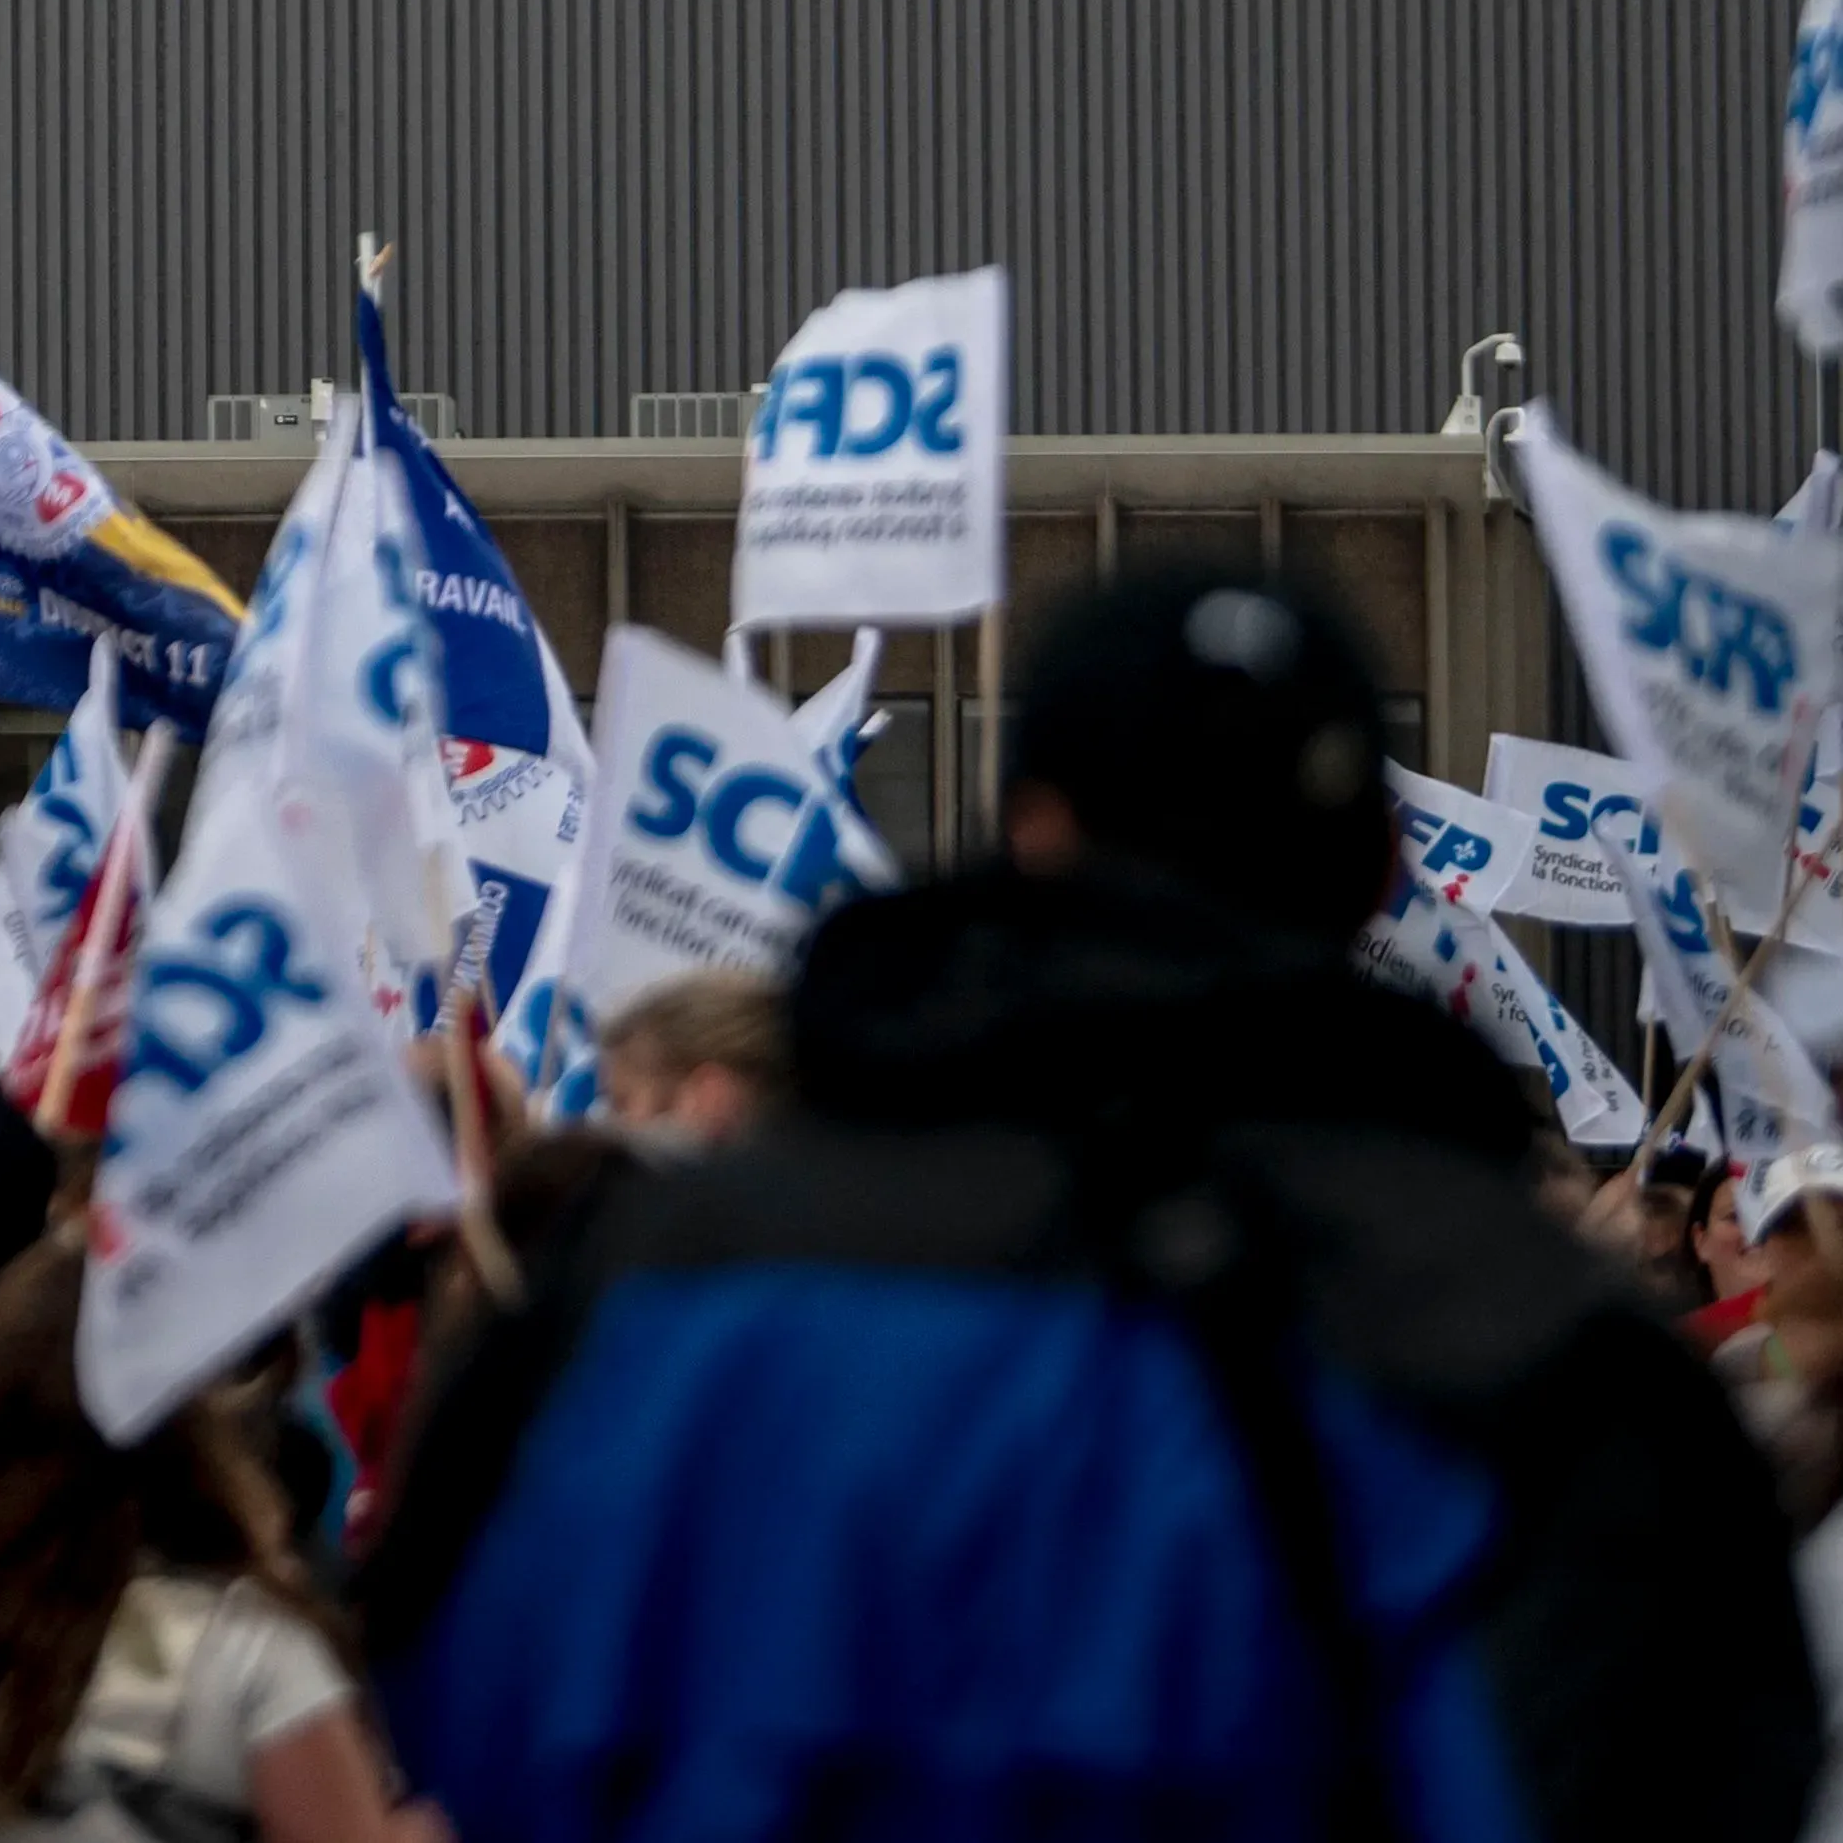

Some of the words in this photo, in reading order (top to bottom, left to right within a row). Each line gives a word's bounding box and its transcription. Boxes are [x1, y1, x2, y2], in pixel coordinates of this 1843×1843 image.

[415, 568, 528, 634] RAVAIL
[164, 638, 211, 689] 11
[1397, 798, 1493, 875] FP
[1533, 843, 1603, 877] Syndicat
[1531, 862, 1548, 880] la
[1550, 867, 1623, 896] fonction
